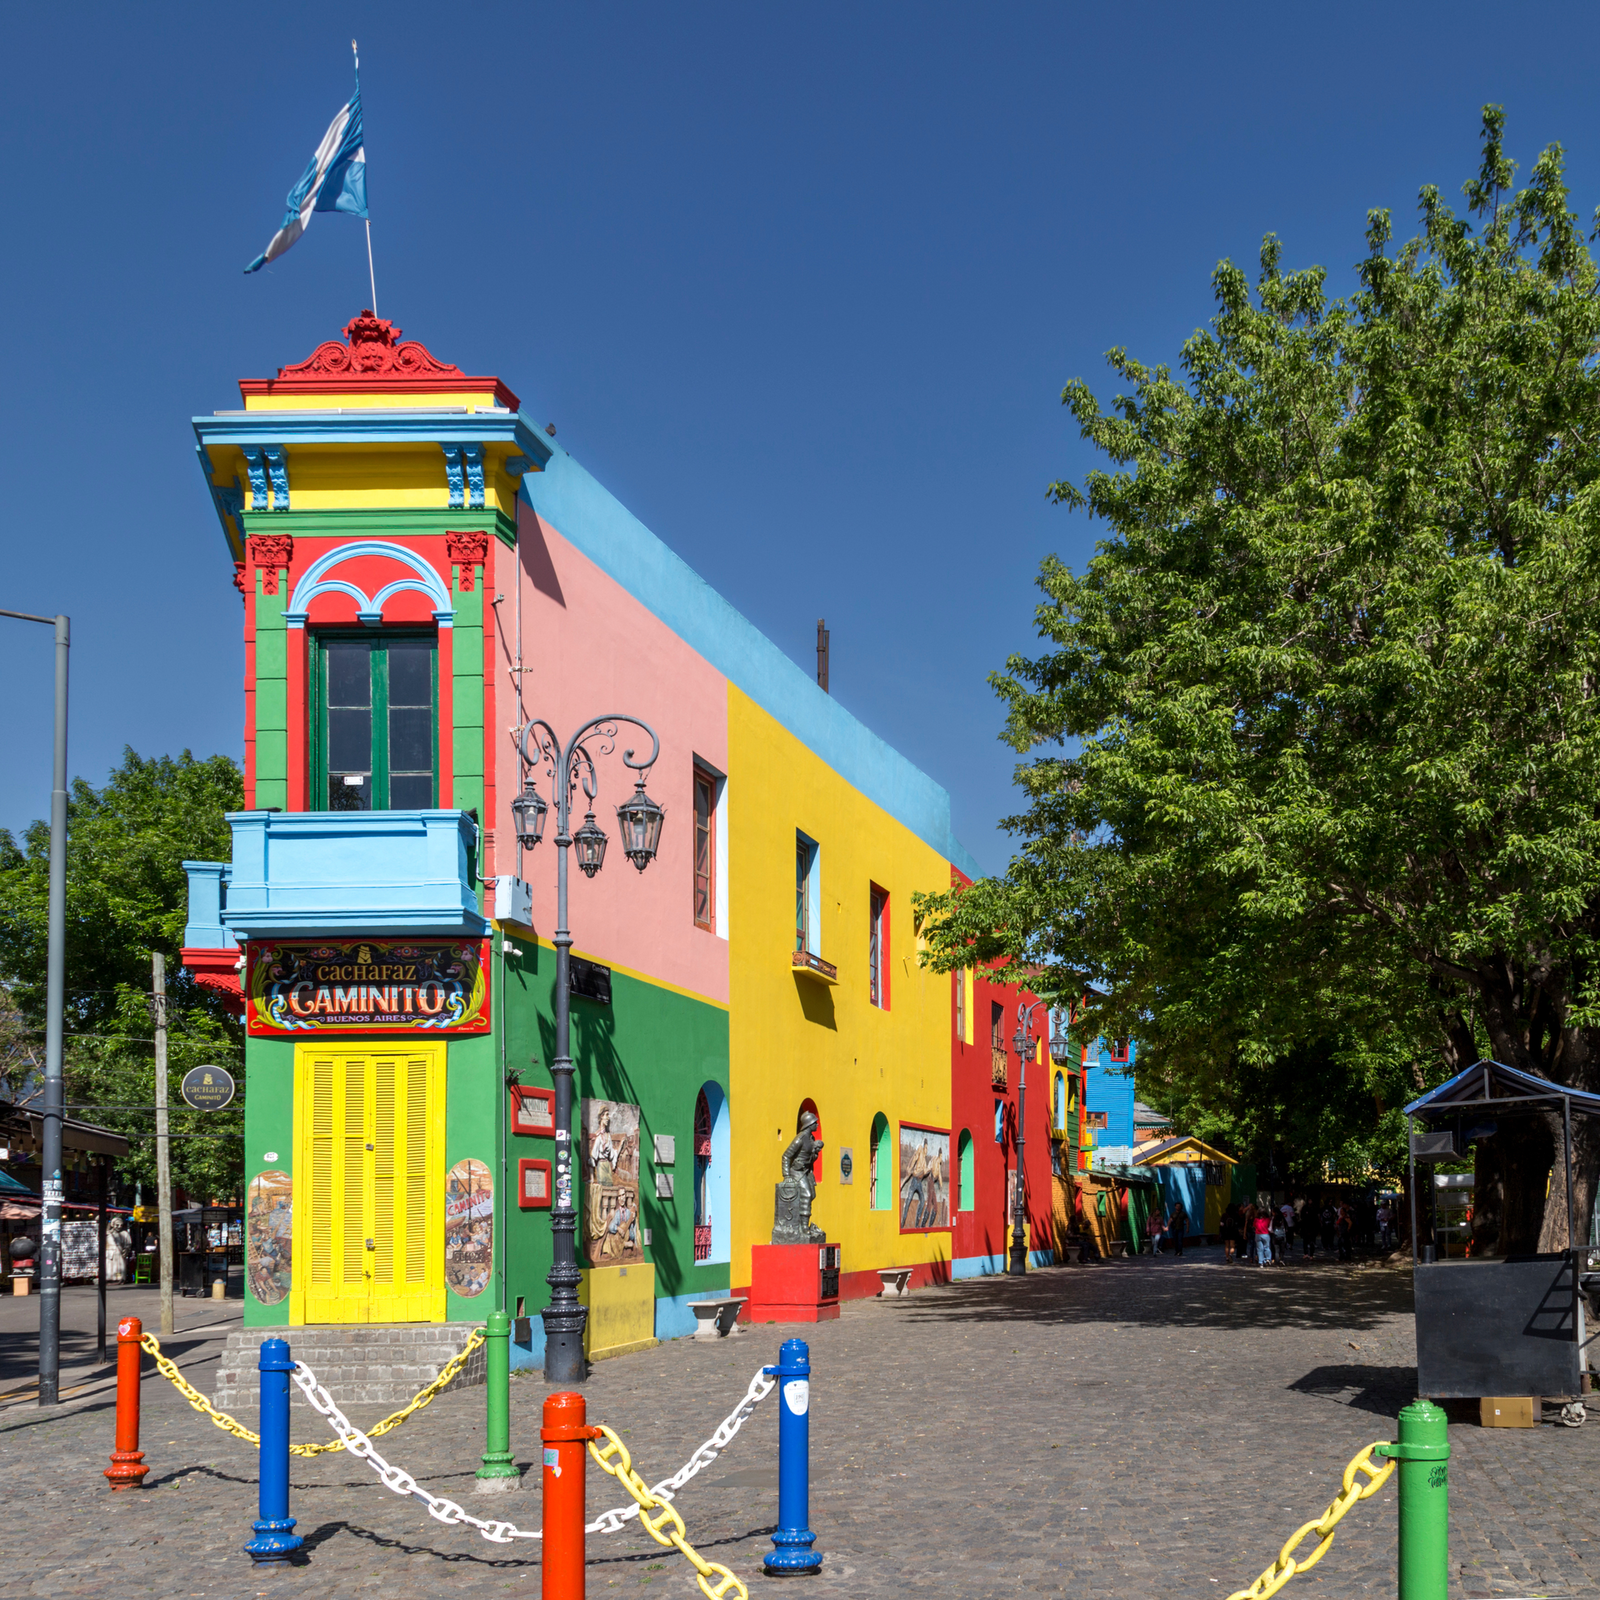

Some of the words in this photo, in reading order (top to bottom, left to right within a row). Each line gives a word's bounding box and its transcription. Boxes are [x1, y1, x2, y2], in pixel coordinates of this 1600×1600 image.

[288, 980, 446, 1015] CAMINITO
[326, 1015, 370, 1023] BUENOS
[447, 1190, 491, 1216] CAMINITO
